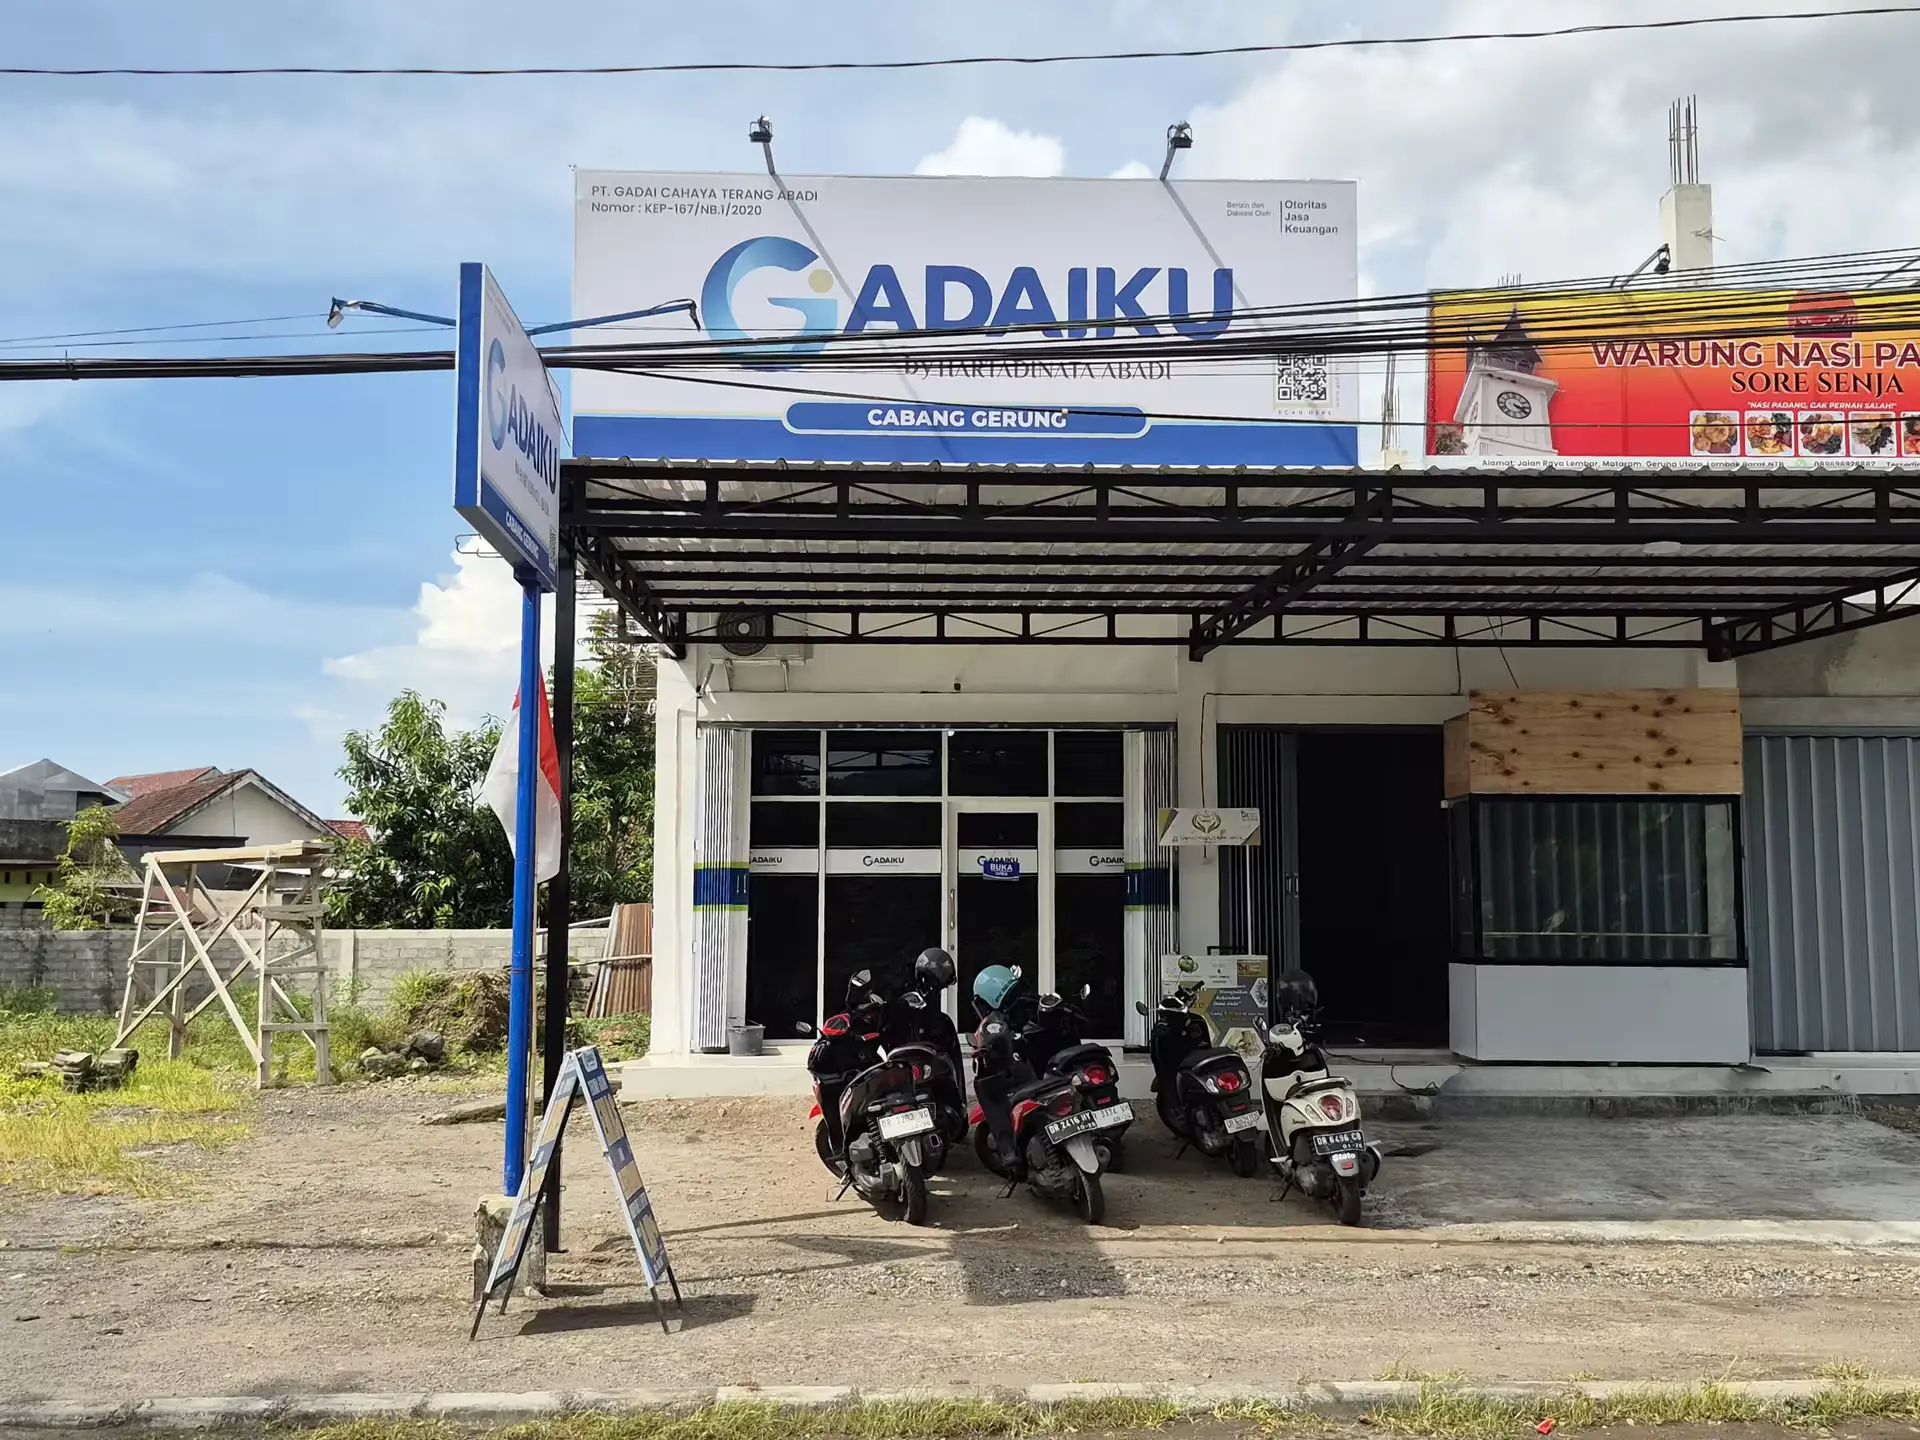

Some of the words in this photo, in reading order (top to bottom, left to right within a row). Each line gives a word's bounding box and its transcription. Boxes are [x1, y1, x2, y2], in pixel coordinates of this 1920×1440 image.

[592, 186, 610, 197] PT.
[614, 186, 656, 198] GADAI
[661, 187, 716, 199] CAHAYA
[721, 188, 773, 200] TERANG
[777, 190, 818, 201] ABADI
[592, 202, 634, 213] Nomor
[645, 203, 762, 216] KEP-167/NB.1/2020
[1284, 200, 1327, 209] Otoritas
[1284, 212, 1310, 221] Jasa
[1284, 224, 1338, 235] Keuangan
[1592, 339, 1764, 368] WARUNG
[1776, 342, 1862, 367] NASI
[1101, 361, 1172, 380] ABADI
[1731, 371, 1809, 393] SORE
[1817, 372, 1904, 398] SENJA
[867, 409, 964, 426] CABANG
[971, 410, 1067, 428] GERUNG
[863, 856, 905, 866] GADAIKU
[990, 863, 1013, 871] BUKA
[1048, 1123, 1060, 1134] DR
[1080, 1111, 1092, 1122] HY
[1316, 1136, 1328, 1146] DR
